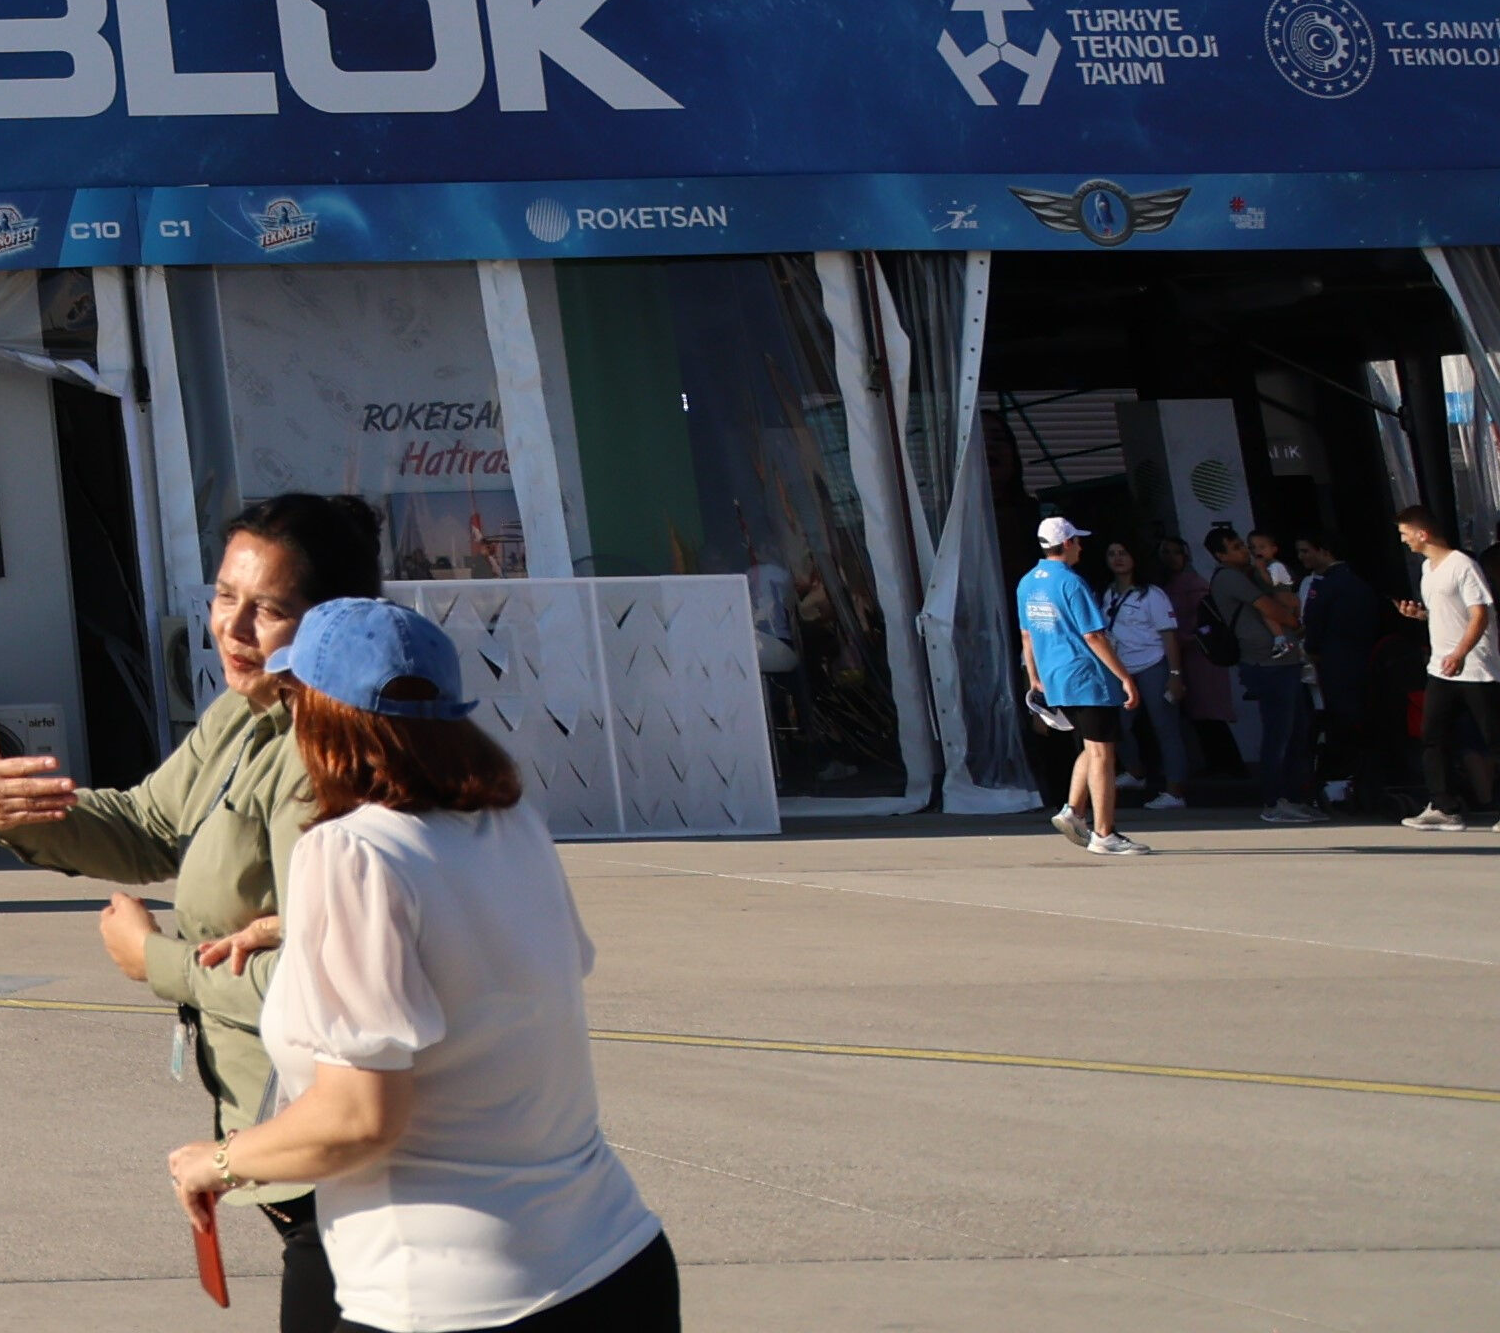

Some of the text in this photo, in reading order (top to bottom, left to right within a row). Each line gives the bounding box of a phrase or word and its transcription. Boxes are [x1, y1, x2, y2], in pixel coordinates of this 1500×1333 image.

[1383, 21, 1421, 40] T.C.
[1075, 62, 1166, 85] TAKIMI
[159, 219, 192, 237] C1
[576, 205, 729, 230] ROKETSAN
[70, 221, 121, 240] C10
[259, 221, 320, 250] TEKNOFEST
[400, 439, 512, 476] Hatıras
[28, 717, 55, 728] airfel
